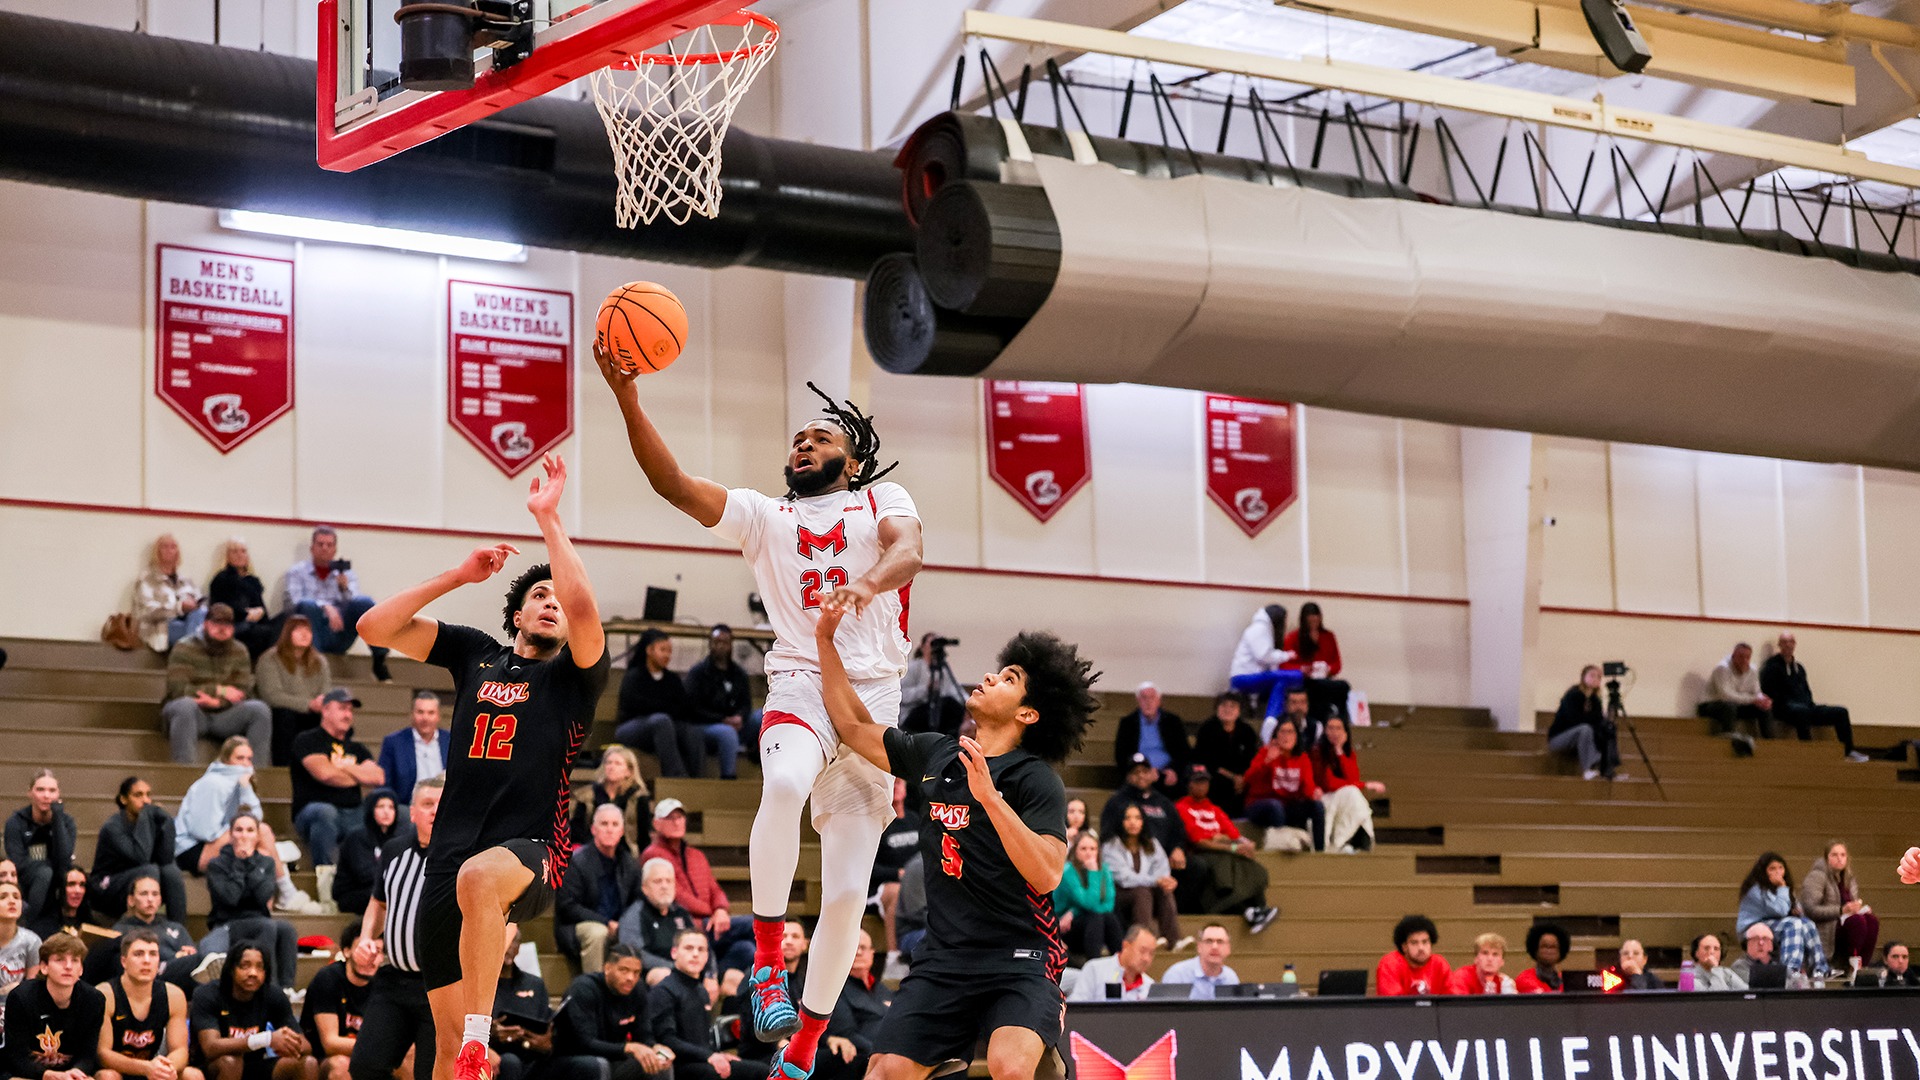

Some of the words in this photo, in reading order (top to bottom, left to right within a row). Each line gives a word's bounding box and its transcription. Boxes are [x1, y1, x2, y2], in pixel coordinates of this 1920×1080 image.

[201, 260, 254, 282] MEN'S
[170, 278, 283, 307] BASKETBALL
[474, 293, 549, 316] WOMEN'S
[460, 311, 563, 337] BASKETBALL
[797, 518, 848, 561] M
[477, 680, 530, 707] UMSL
[468, 712, 518, 760] 12
[941, 832, 963, 879] 5
